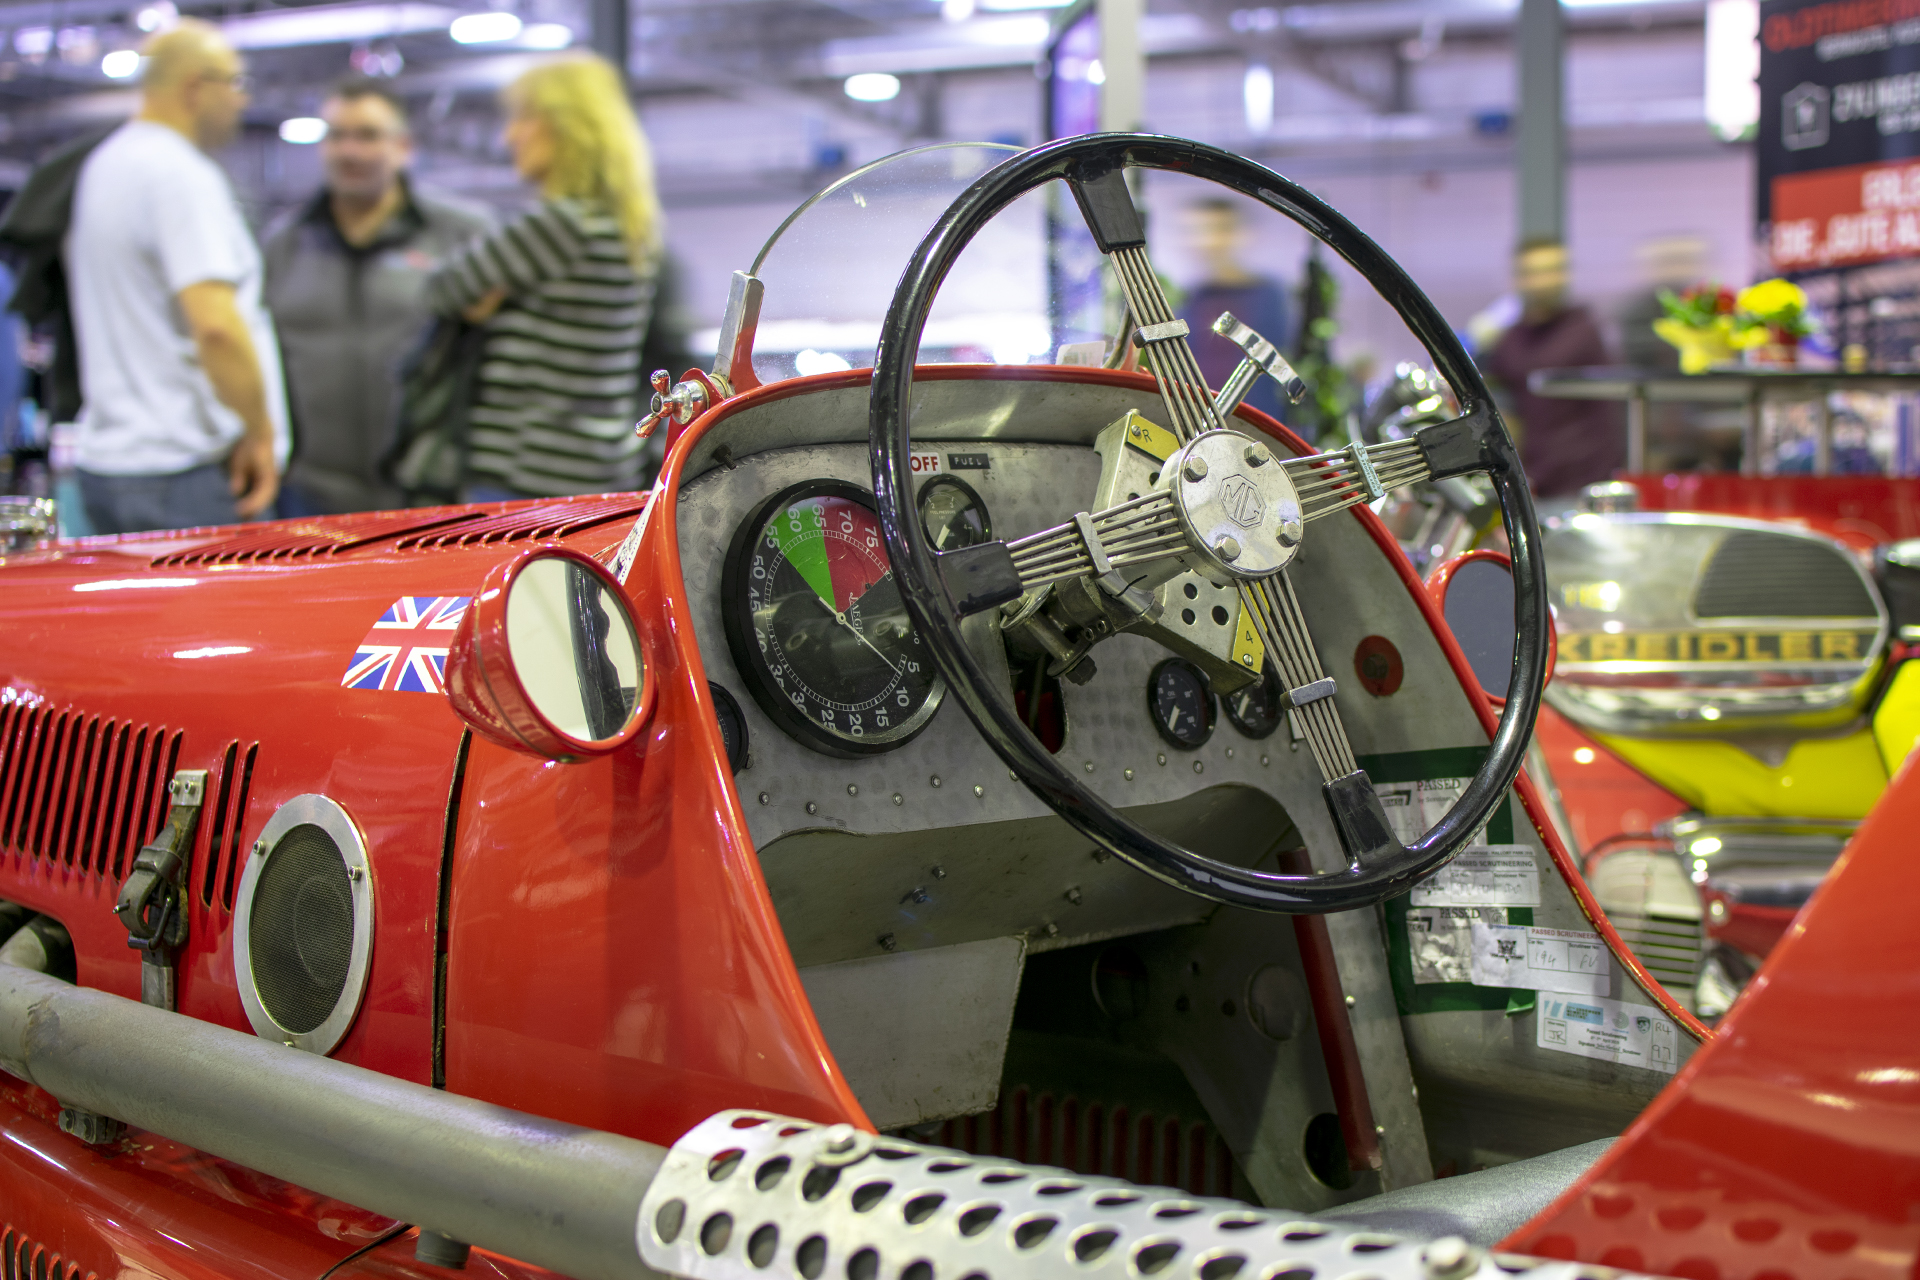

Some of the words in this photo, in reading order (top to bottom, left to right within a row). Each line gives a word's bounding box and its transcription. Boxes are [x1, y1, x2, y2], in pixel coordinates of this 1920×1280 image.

[1142, 428, 1153, 443] R
[910, 456, 938, 471] OFF
[954, 457, 982, 466] FUEL
[1220, 482, 1262, 525] MG
[787, 507, 802, 532] 60
[812, 504, 827, 527] 65
[839, 511, 853, 533] 70
[766, 525, 780, 548] 55
[865, 526, 879, 547] 75
[753, 555, 766, 579] 50
[1246, 630, 1254, 644] 4
[1556, 631, 1860, 661] KREIDLER
[907, 661, 920, 674] 5
[896, 686, 909, 707] 10
[821, 710, 837, 731] 25
[849, 714, 863, 737] 20
[875, 707, 890, 727] 15
[1416, 779, 1461, 791] PASSED
[1479, 860, 1533, 868] SCRUTINEERING
[1440, 907, 1480, 919] PASSED
[1531, 928, 1555, 936] PASSED
[1557, 930, 1601, 940] SCRUTINEERIN
[1651, 1044, 1671, 1060] 97
